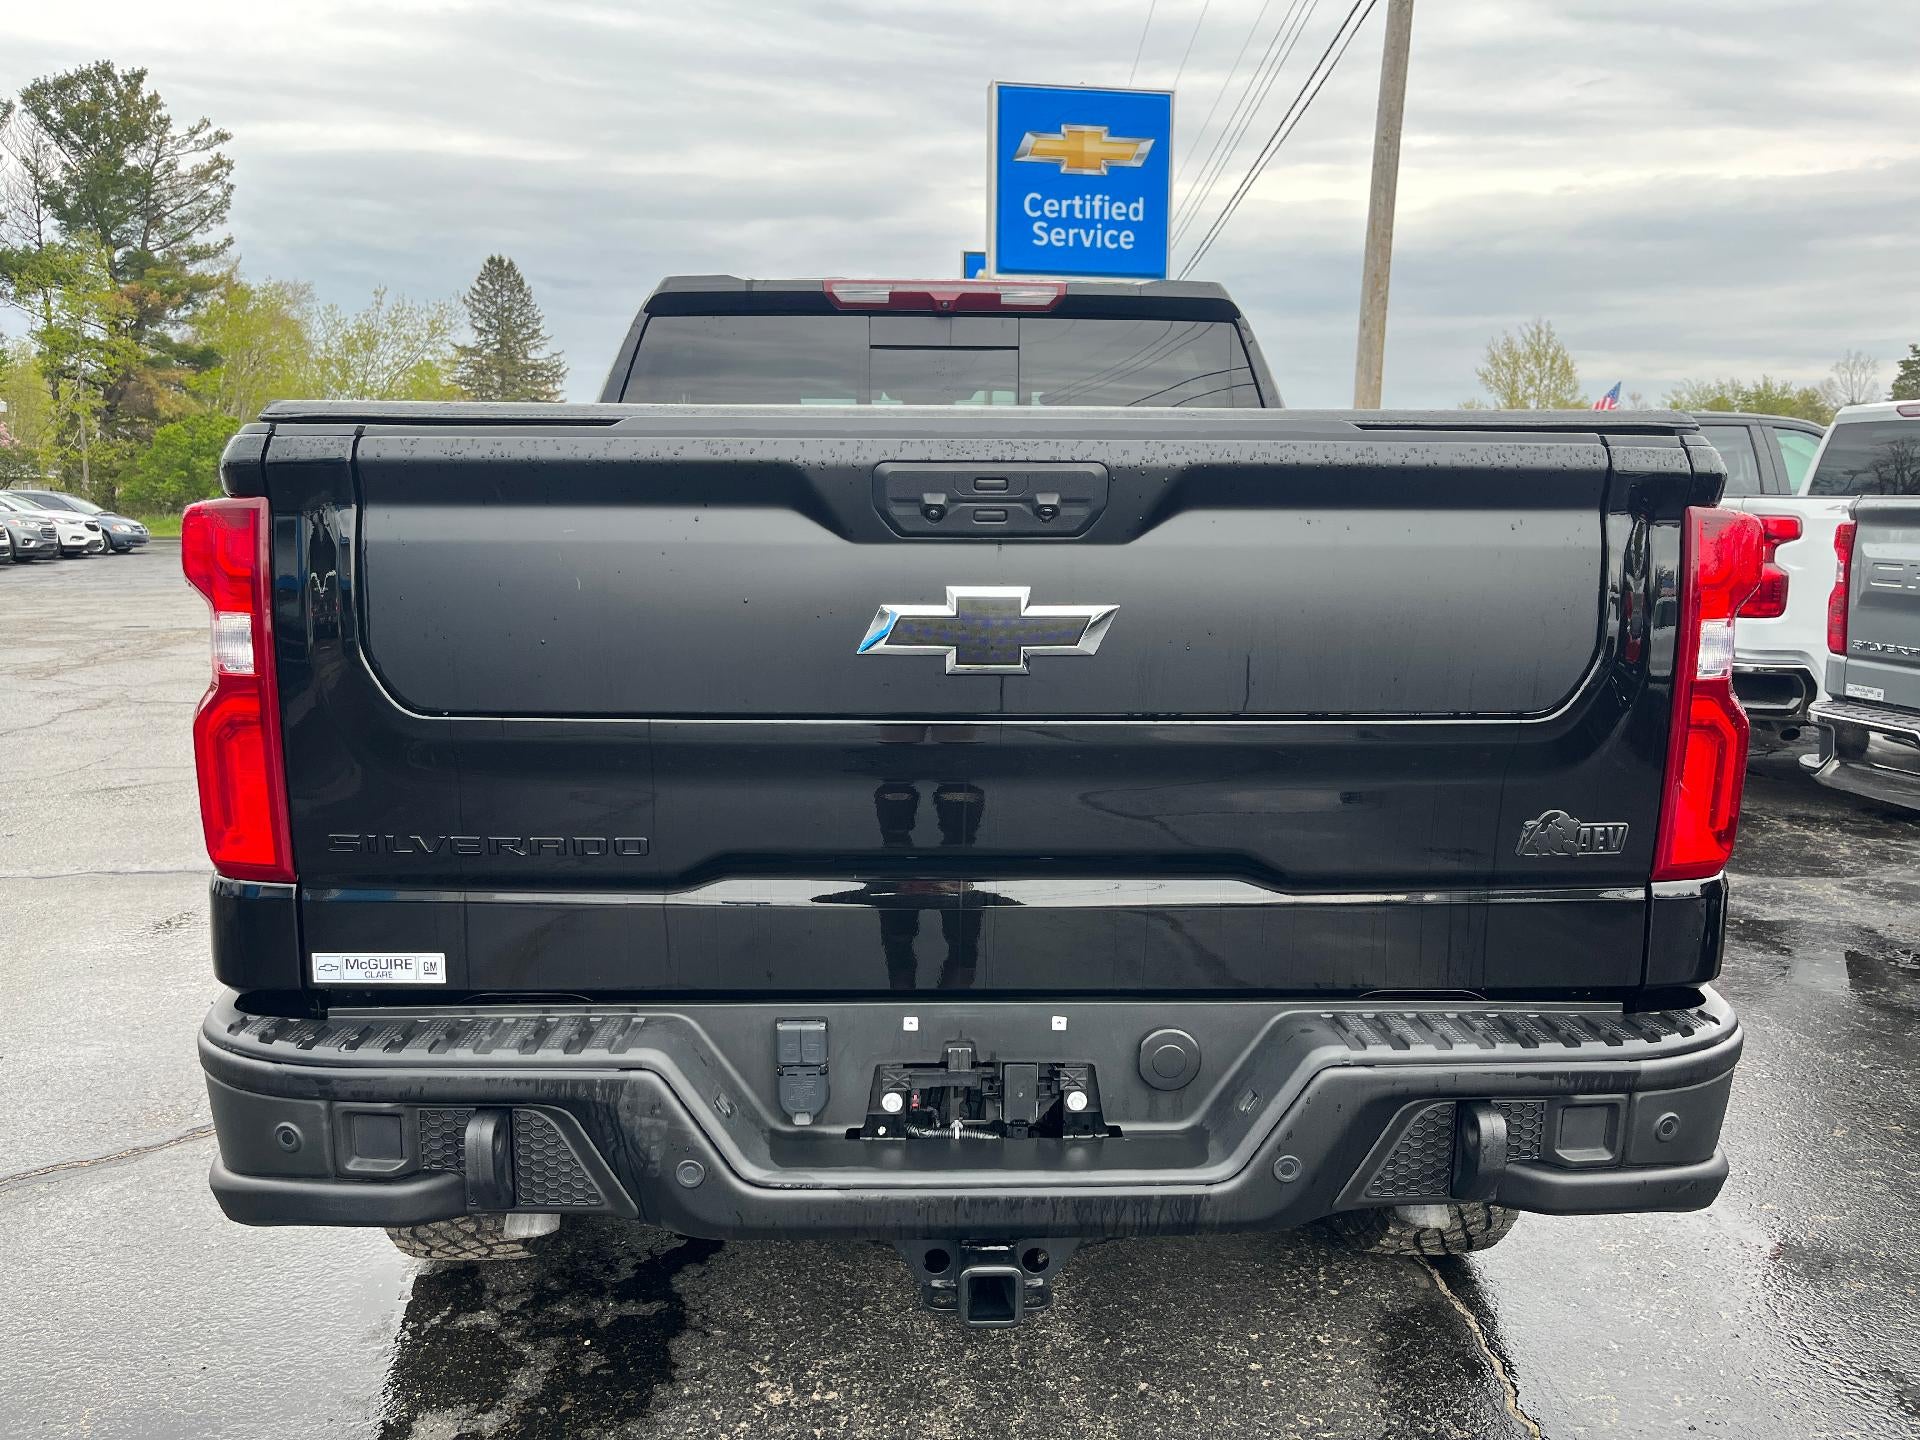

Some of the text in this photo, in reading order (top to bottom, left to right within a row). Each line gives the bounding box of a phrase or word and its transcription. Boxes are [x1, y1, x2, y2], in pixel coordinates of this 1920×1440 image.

[1024, 193, 1144, 221] Certified
[1032, 221, 1135, 249] Service
[327, 834, 650, 856] SILVERADO
[1578, 826, 1625, 851] AEV
[345, 959, 413, 970] McGUIRE
[364, 971, 393, 979] CLARE
[423, 962, 438, 972] GM
